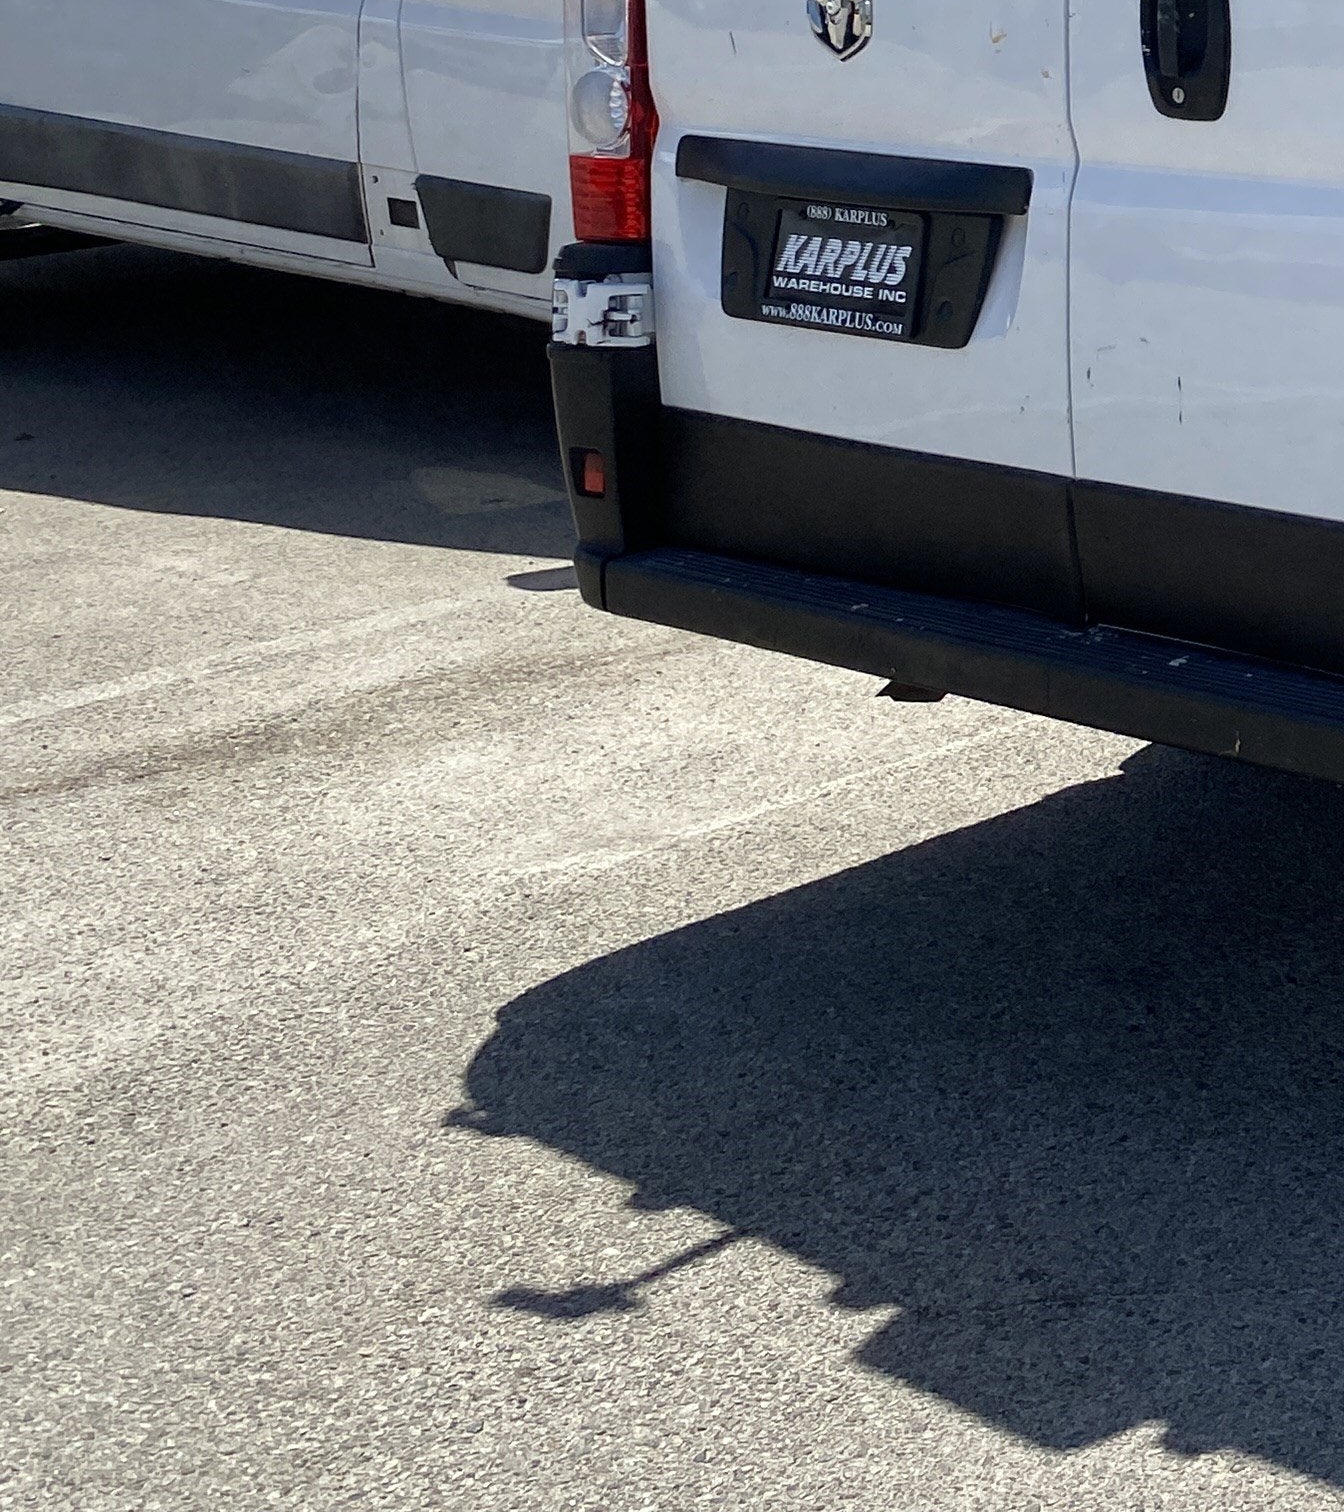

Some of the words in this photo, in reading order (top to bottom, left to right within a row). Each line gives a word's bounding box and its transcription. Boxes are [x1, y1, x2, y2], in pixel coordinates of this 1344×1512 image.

[806, 205, 833, 220] (888)
[834, 207, 888, 227] KARPLUS
[775, 234, 913, 286] KARPLUS
[772, 275, 874, 299] WAREHOUSE
[878, 288, 907, 303] INC
